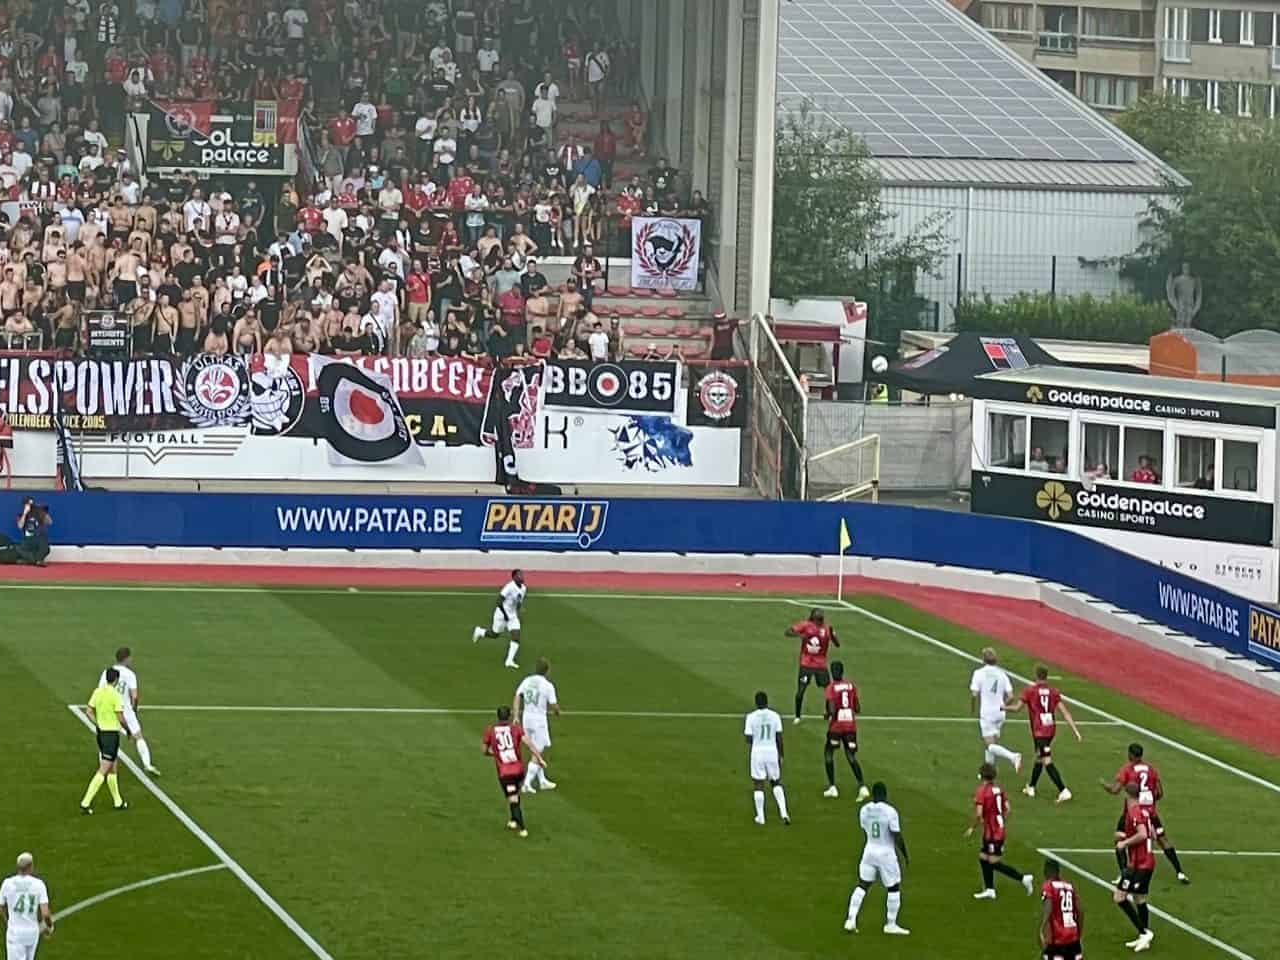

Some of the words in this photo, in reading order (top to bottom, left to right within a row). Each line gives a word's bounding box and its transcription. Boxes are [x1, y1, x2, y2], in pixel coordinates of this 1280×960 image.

[201, 147, 270, 164] palace
[628, 370, 671, 401] 85
[1047, 389, 1151, 412] Goldenpalace
[1154, 404, 1186, 414] CASINO
[1190, 407, 1220, 418] SPORTS
[6, 414, 52, 429] OLENBEEK
[110, 432, 198, 444] FOOTBALL
[1076, 490, 1206, 520] Goldenpalace
[1076, 508, 1115, 521] CASINO
[1119, 511, 1156, 526] SPORTS
[277, 506, 462, 532] WWW.PATAR.BE
[486, 504, 575, 531] PATAR
[1158, 580, 1240, 637] WWW.PATAR.BE
[1139, 771, 1150, 792] 2
